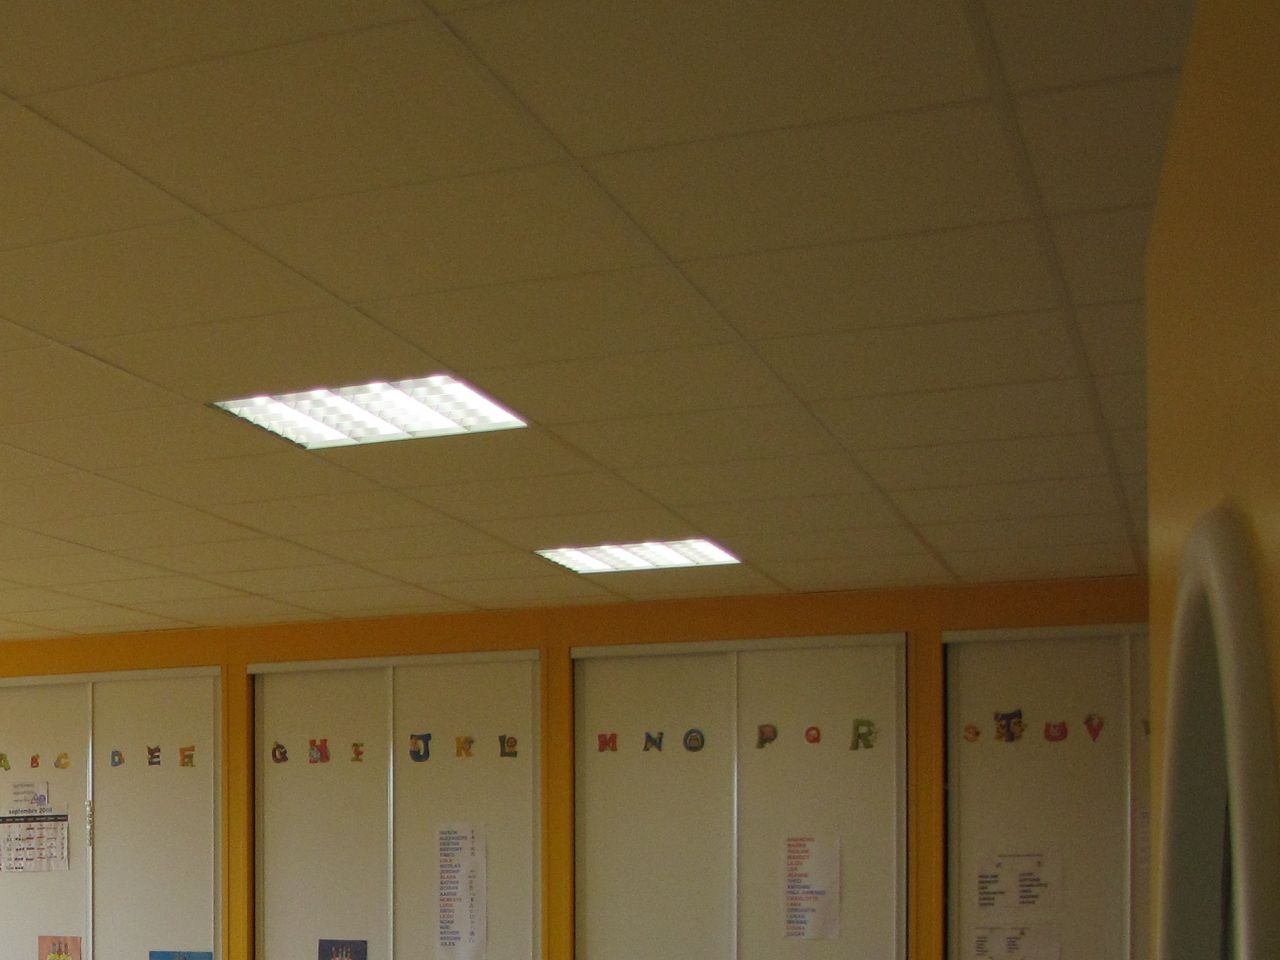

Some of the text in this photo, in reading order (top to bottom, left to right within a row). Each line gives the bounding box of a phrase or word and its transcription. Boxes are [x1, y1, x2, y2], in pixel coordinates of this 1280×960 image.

[598, 729, 705, 752] M N O
[756, 719, 876, 751] P Q R
[111, 750, 125, 767] D
[147, 745, 161, 766] E
[272, 742, 289, 763] G
[309, 739, 330, 764] H
[410, 733, 518, 762] J K L
[31, 753, 41, 768] B
